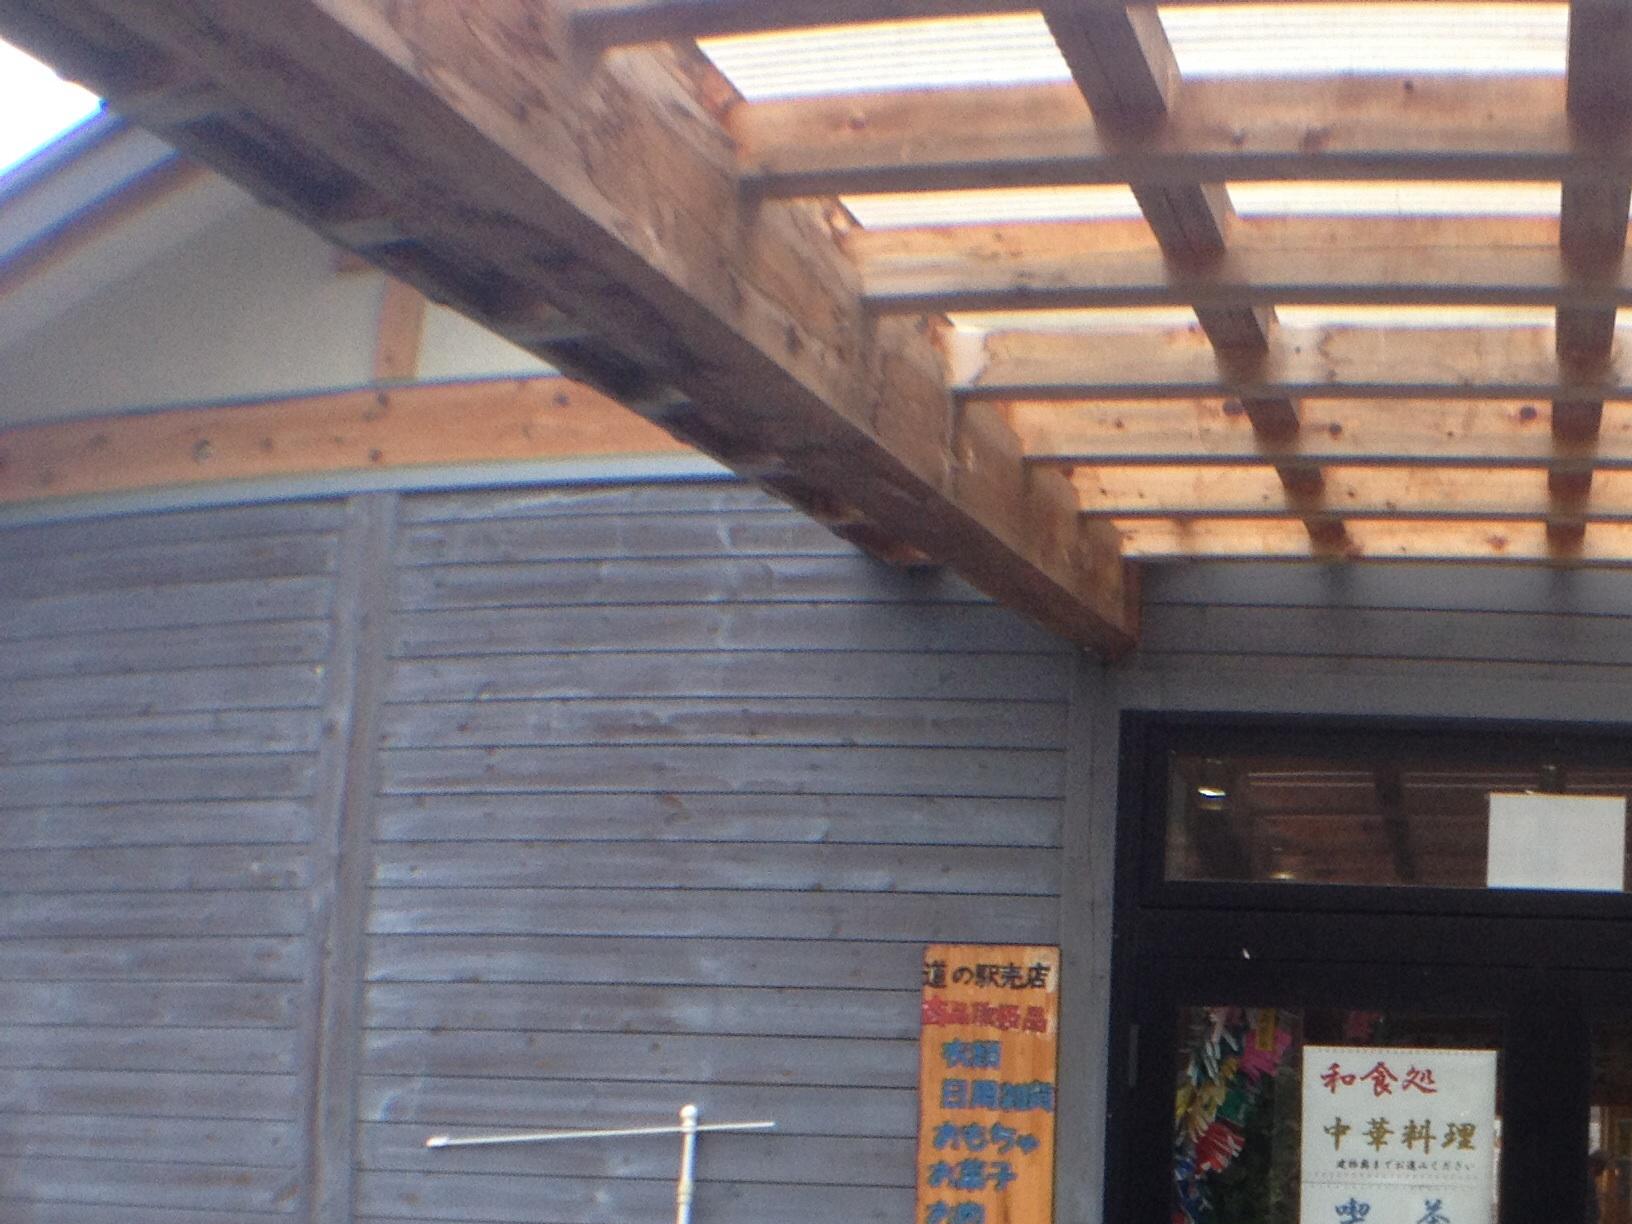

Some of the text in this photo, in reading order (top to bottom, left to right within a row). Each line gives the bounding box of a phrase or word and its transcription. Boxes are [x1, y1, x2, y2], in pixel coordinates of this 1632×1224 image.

[921, 959, 1051, 990] 道の駅売店
[1320, 1061, 1437, 1097] 和食処
[1323, 1116, 1478, 1154] 中華料理
